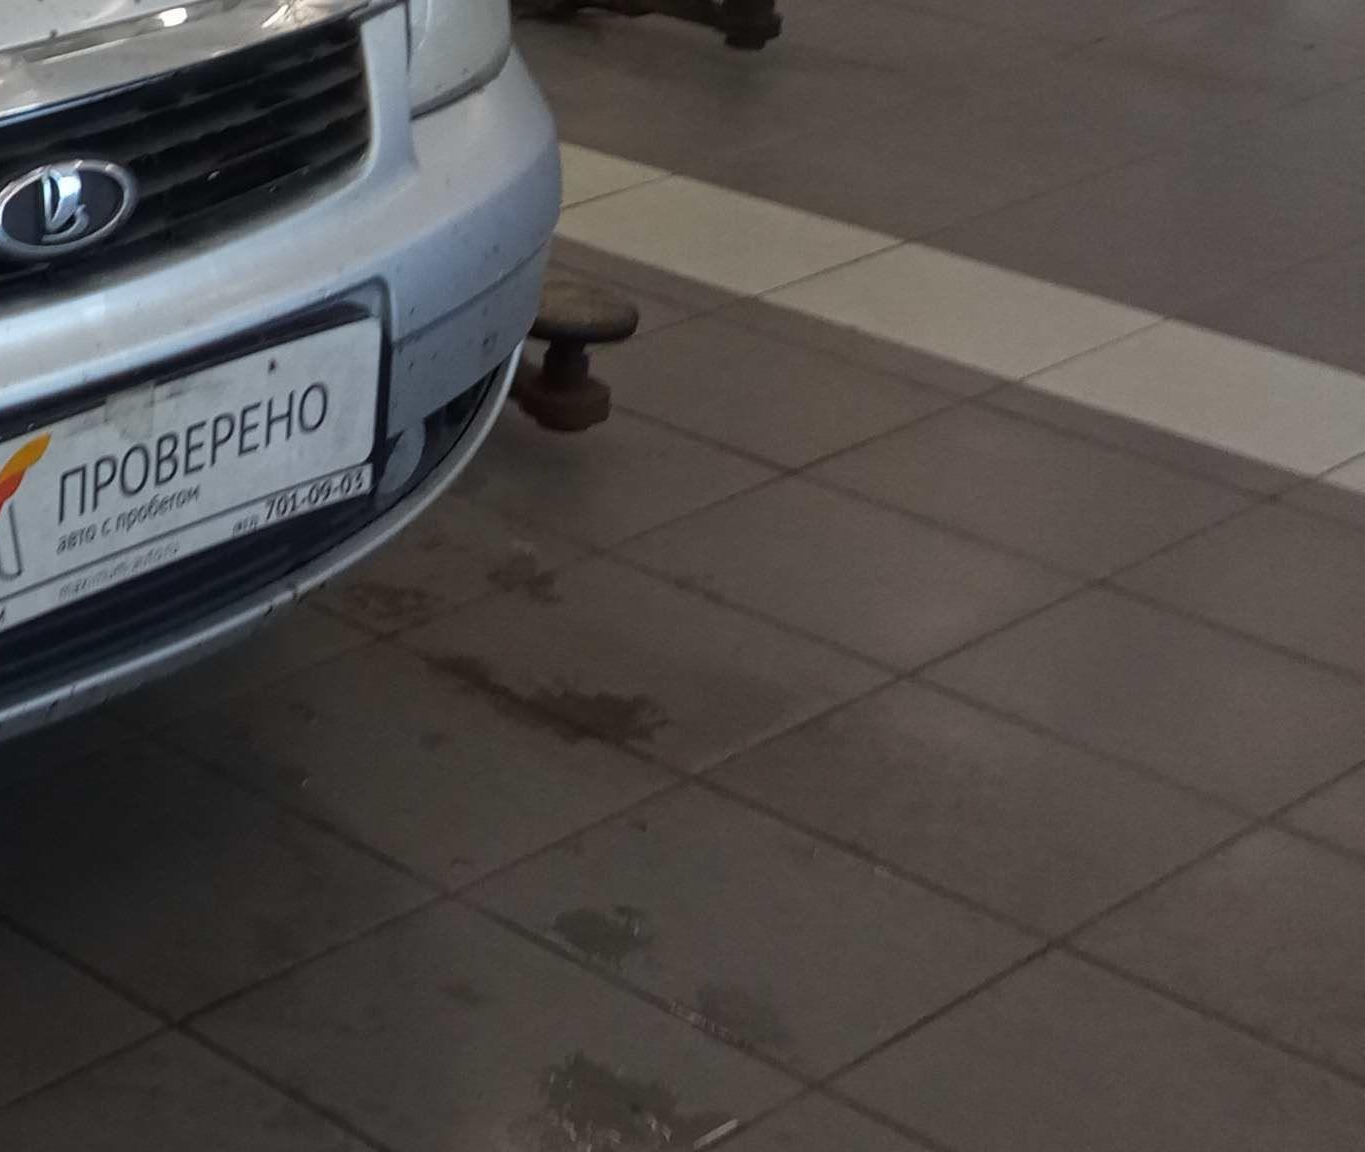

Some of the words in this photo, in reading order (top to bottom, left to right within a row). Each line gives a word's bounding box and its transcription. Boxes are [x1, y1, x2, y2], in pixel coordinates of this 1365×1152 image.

[57, 381, 329, 526] ПРОВЕРЕНО
[56, 523, 98, 556] авто
[101, 517, 112, 537] с
[115, 484, 201, 533] пробегом
